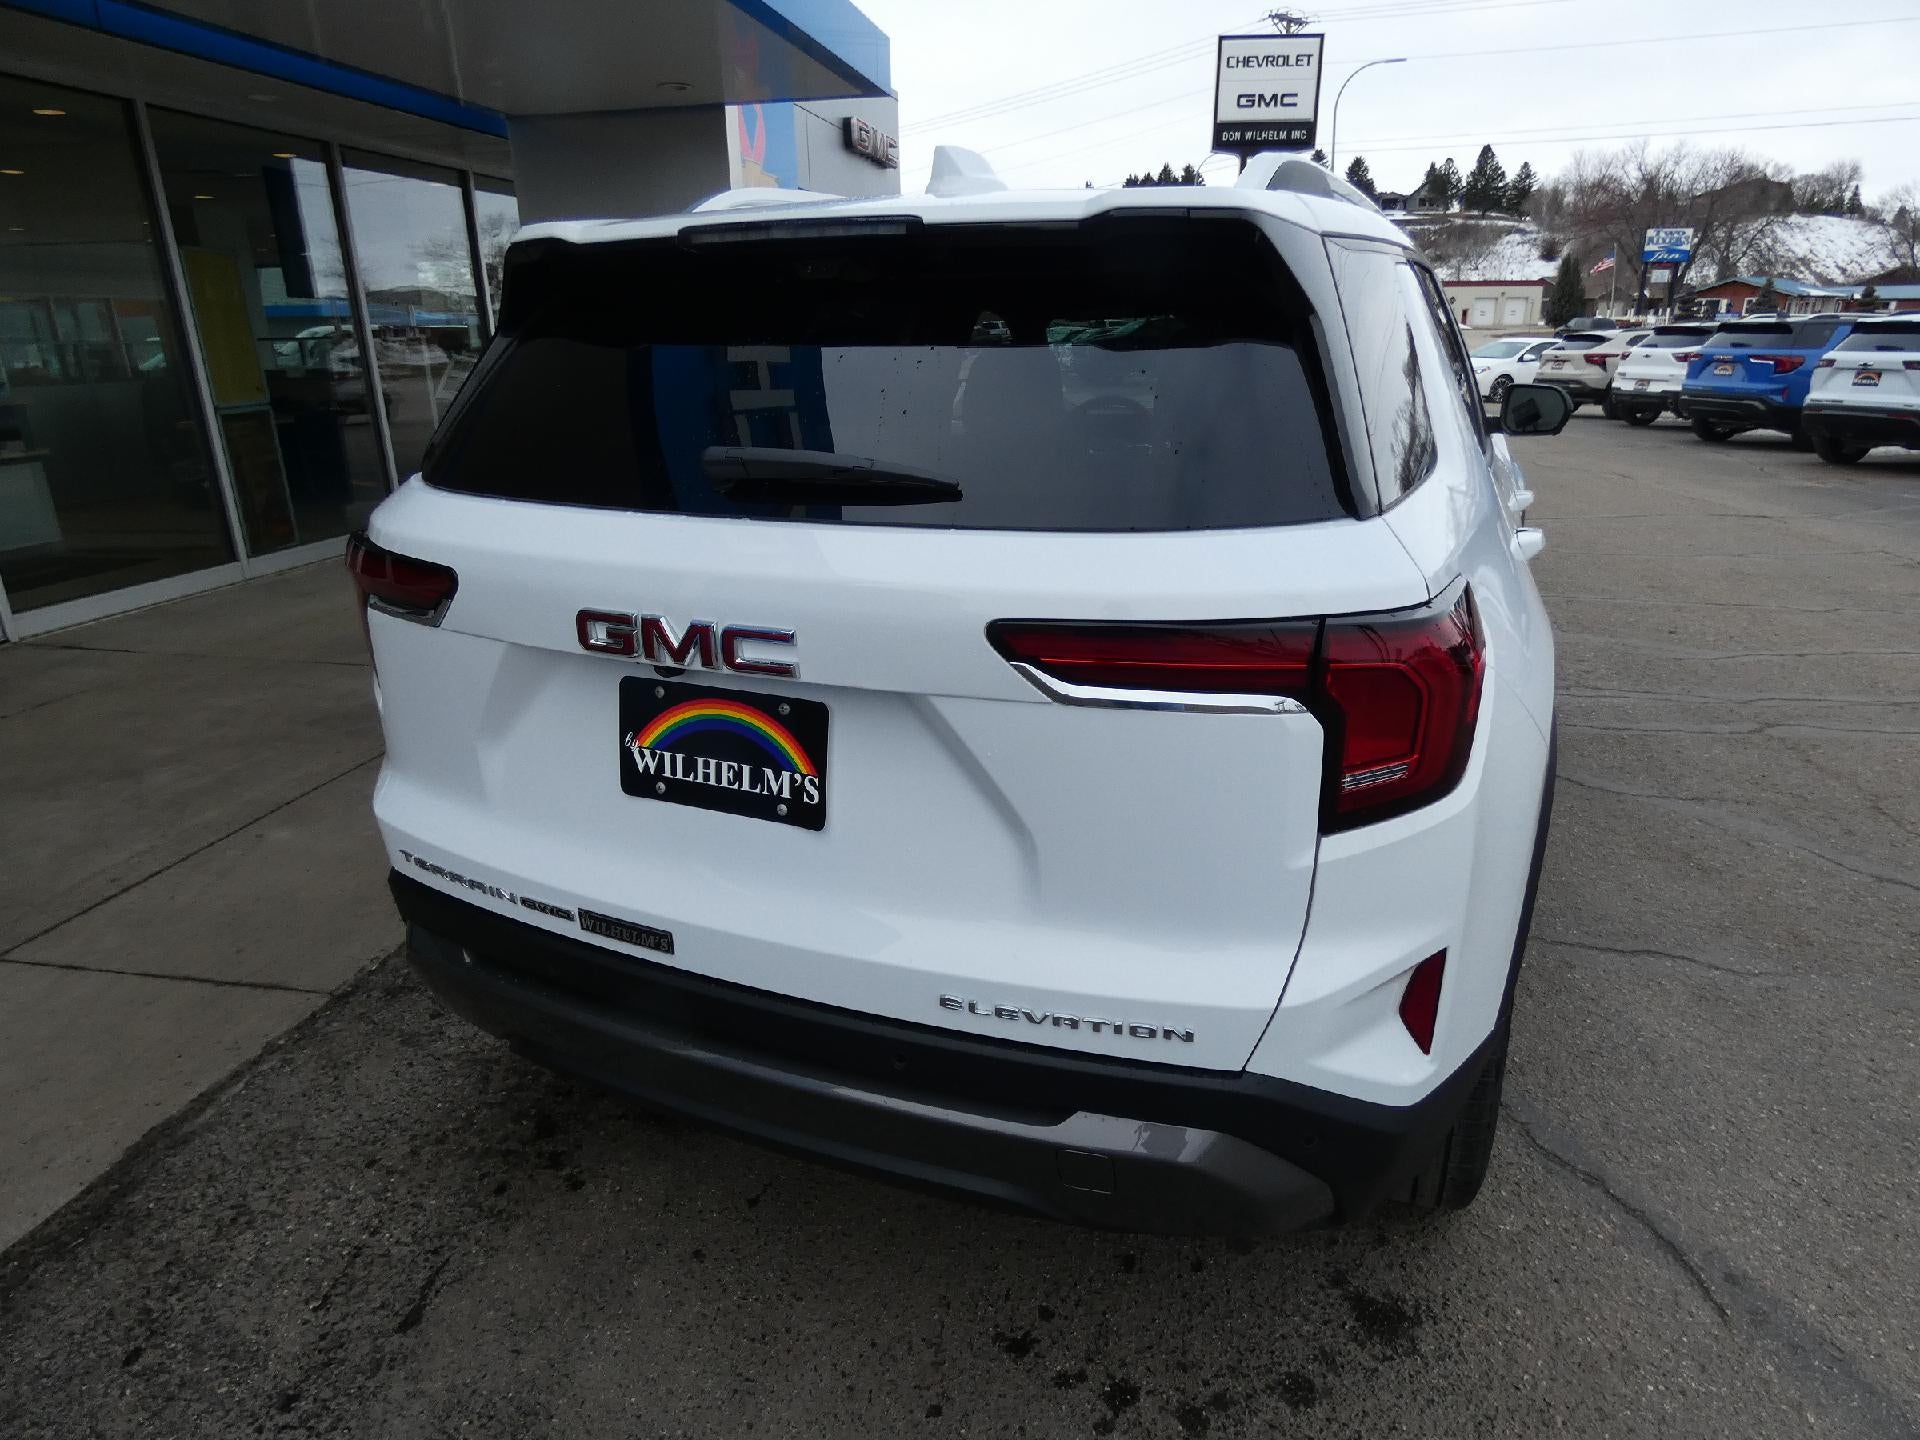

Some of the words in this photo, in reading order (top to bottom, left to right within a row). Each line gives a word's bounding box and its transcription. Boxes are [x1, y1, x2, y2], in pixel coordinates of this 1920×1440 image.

[1226, 53, 1313, 68] CHEVROLET
[1236, 92, 1298, 109] GMC
[849, 115, 898, 170] GMC
[1222, 131, 1241, 141] DON
[1245, 130, 1287, 141] WILHELM
[1291, 130, 1307, 140] INC
[576, 608, 801, 679] GMC
[630, 746, 820, 805] WILHELM'S
[580, 915, 670, 951] WILHELM'S
[939, 993, 1194, 1043] ELEVATION
